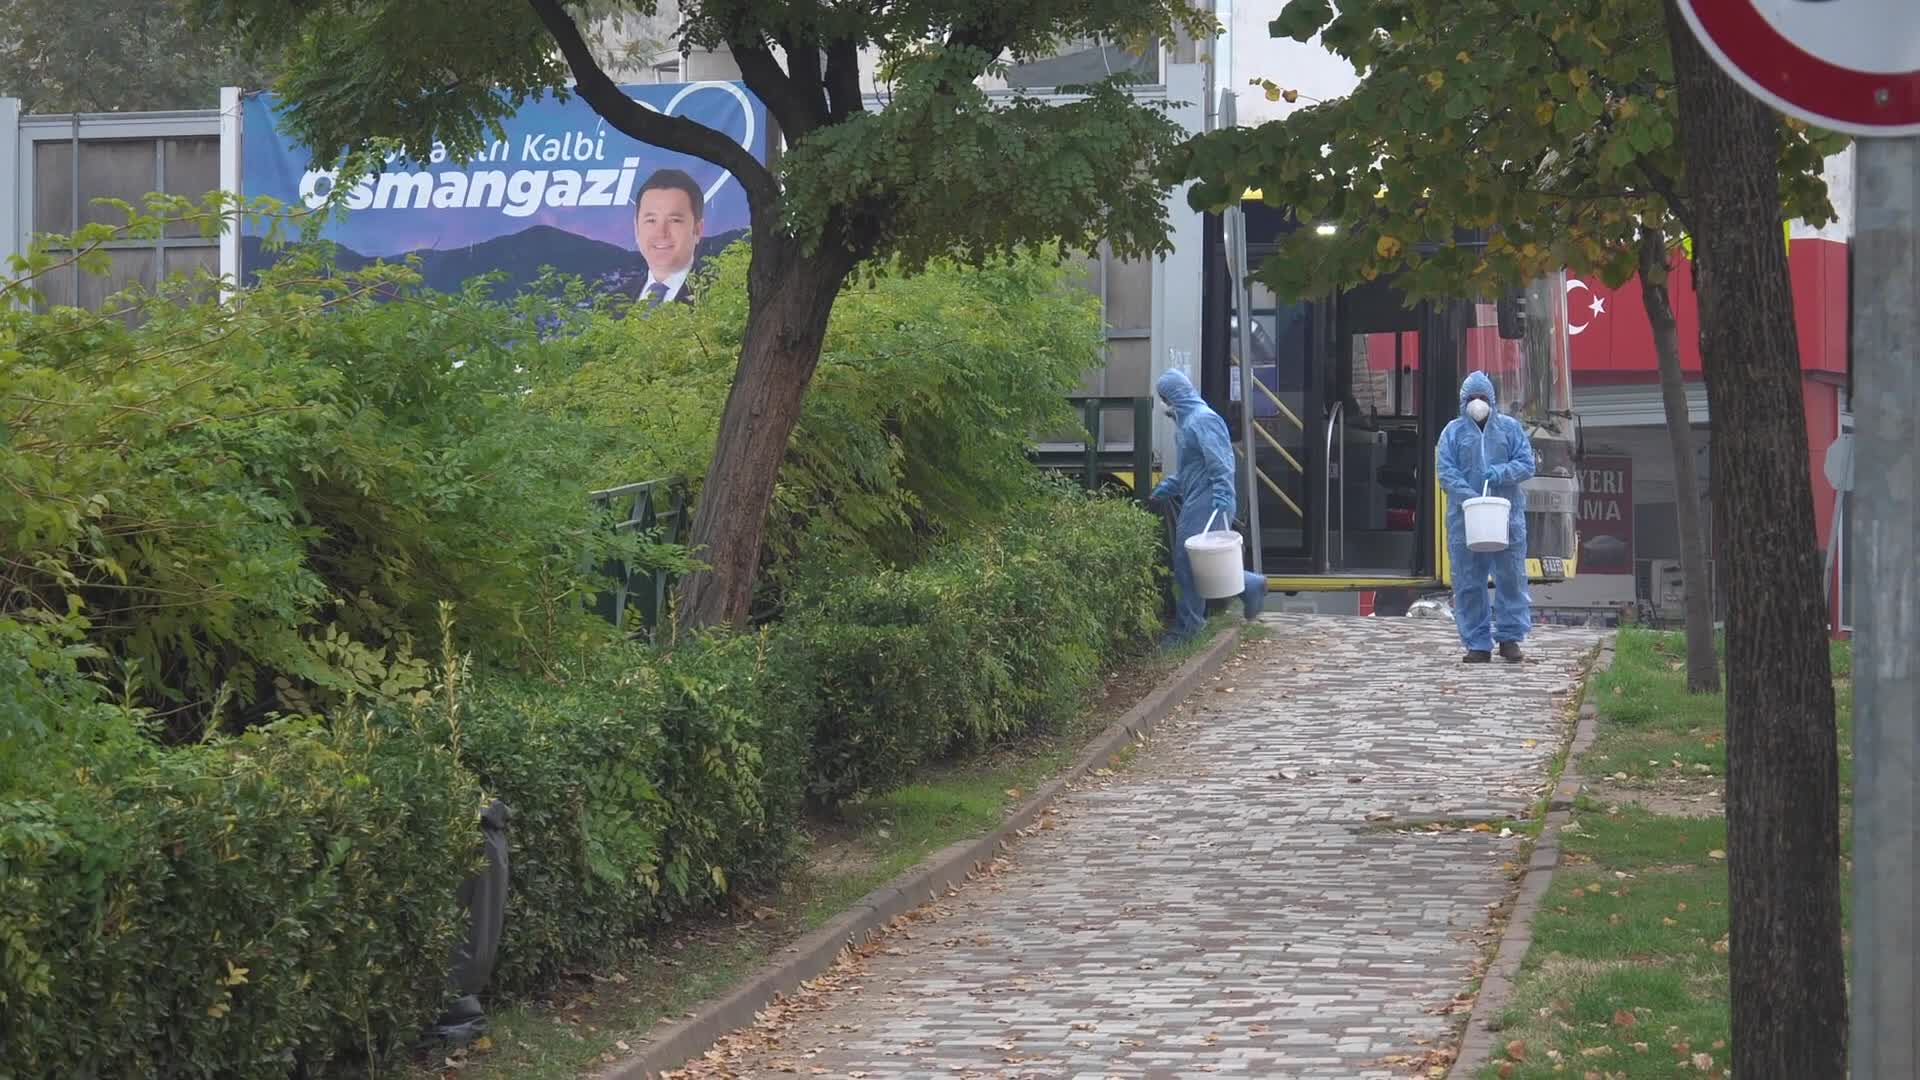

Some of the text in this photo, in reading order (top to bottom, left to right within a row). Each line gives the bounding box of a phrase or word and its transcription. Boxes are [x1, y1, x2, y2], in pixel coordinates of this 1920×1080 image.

[522, 131, 606, 161] Kalbi
[298, 157, 640, 217] Osmangazi
[1576, 500, 1621, 520] MA
